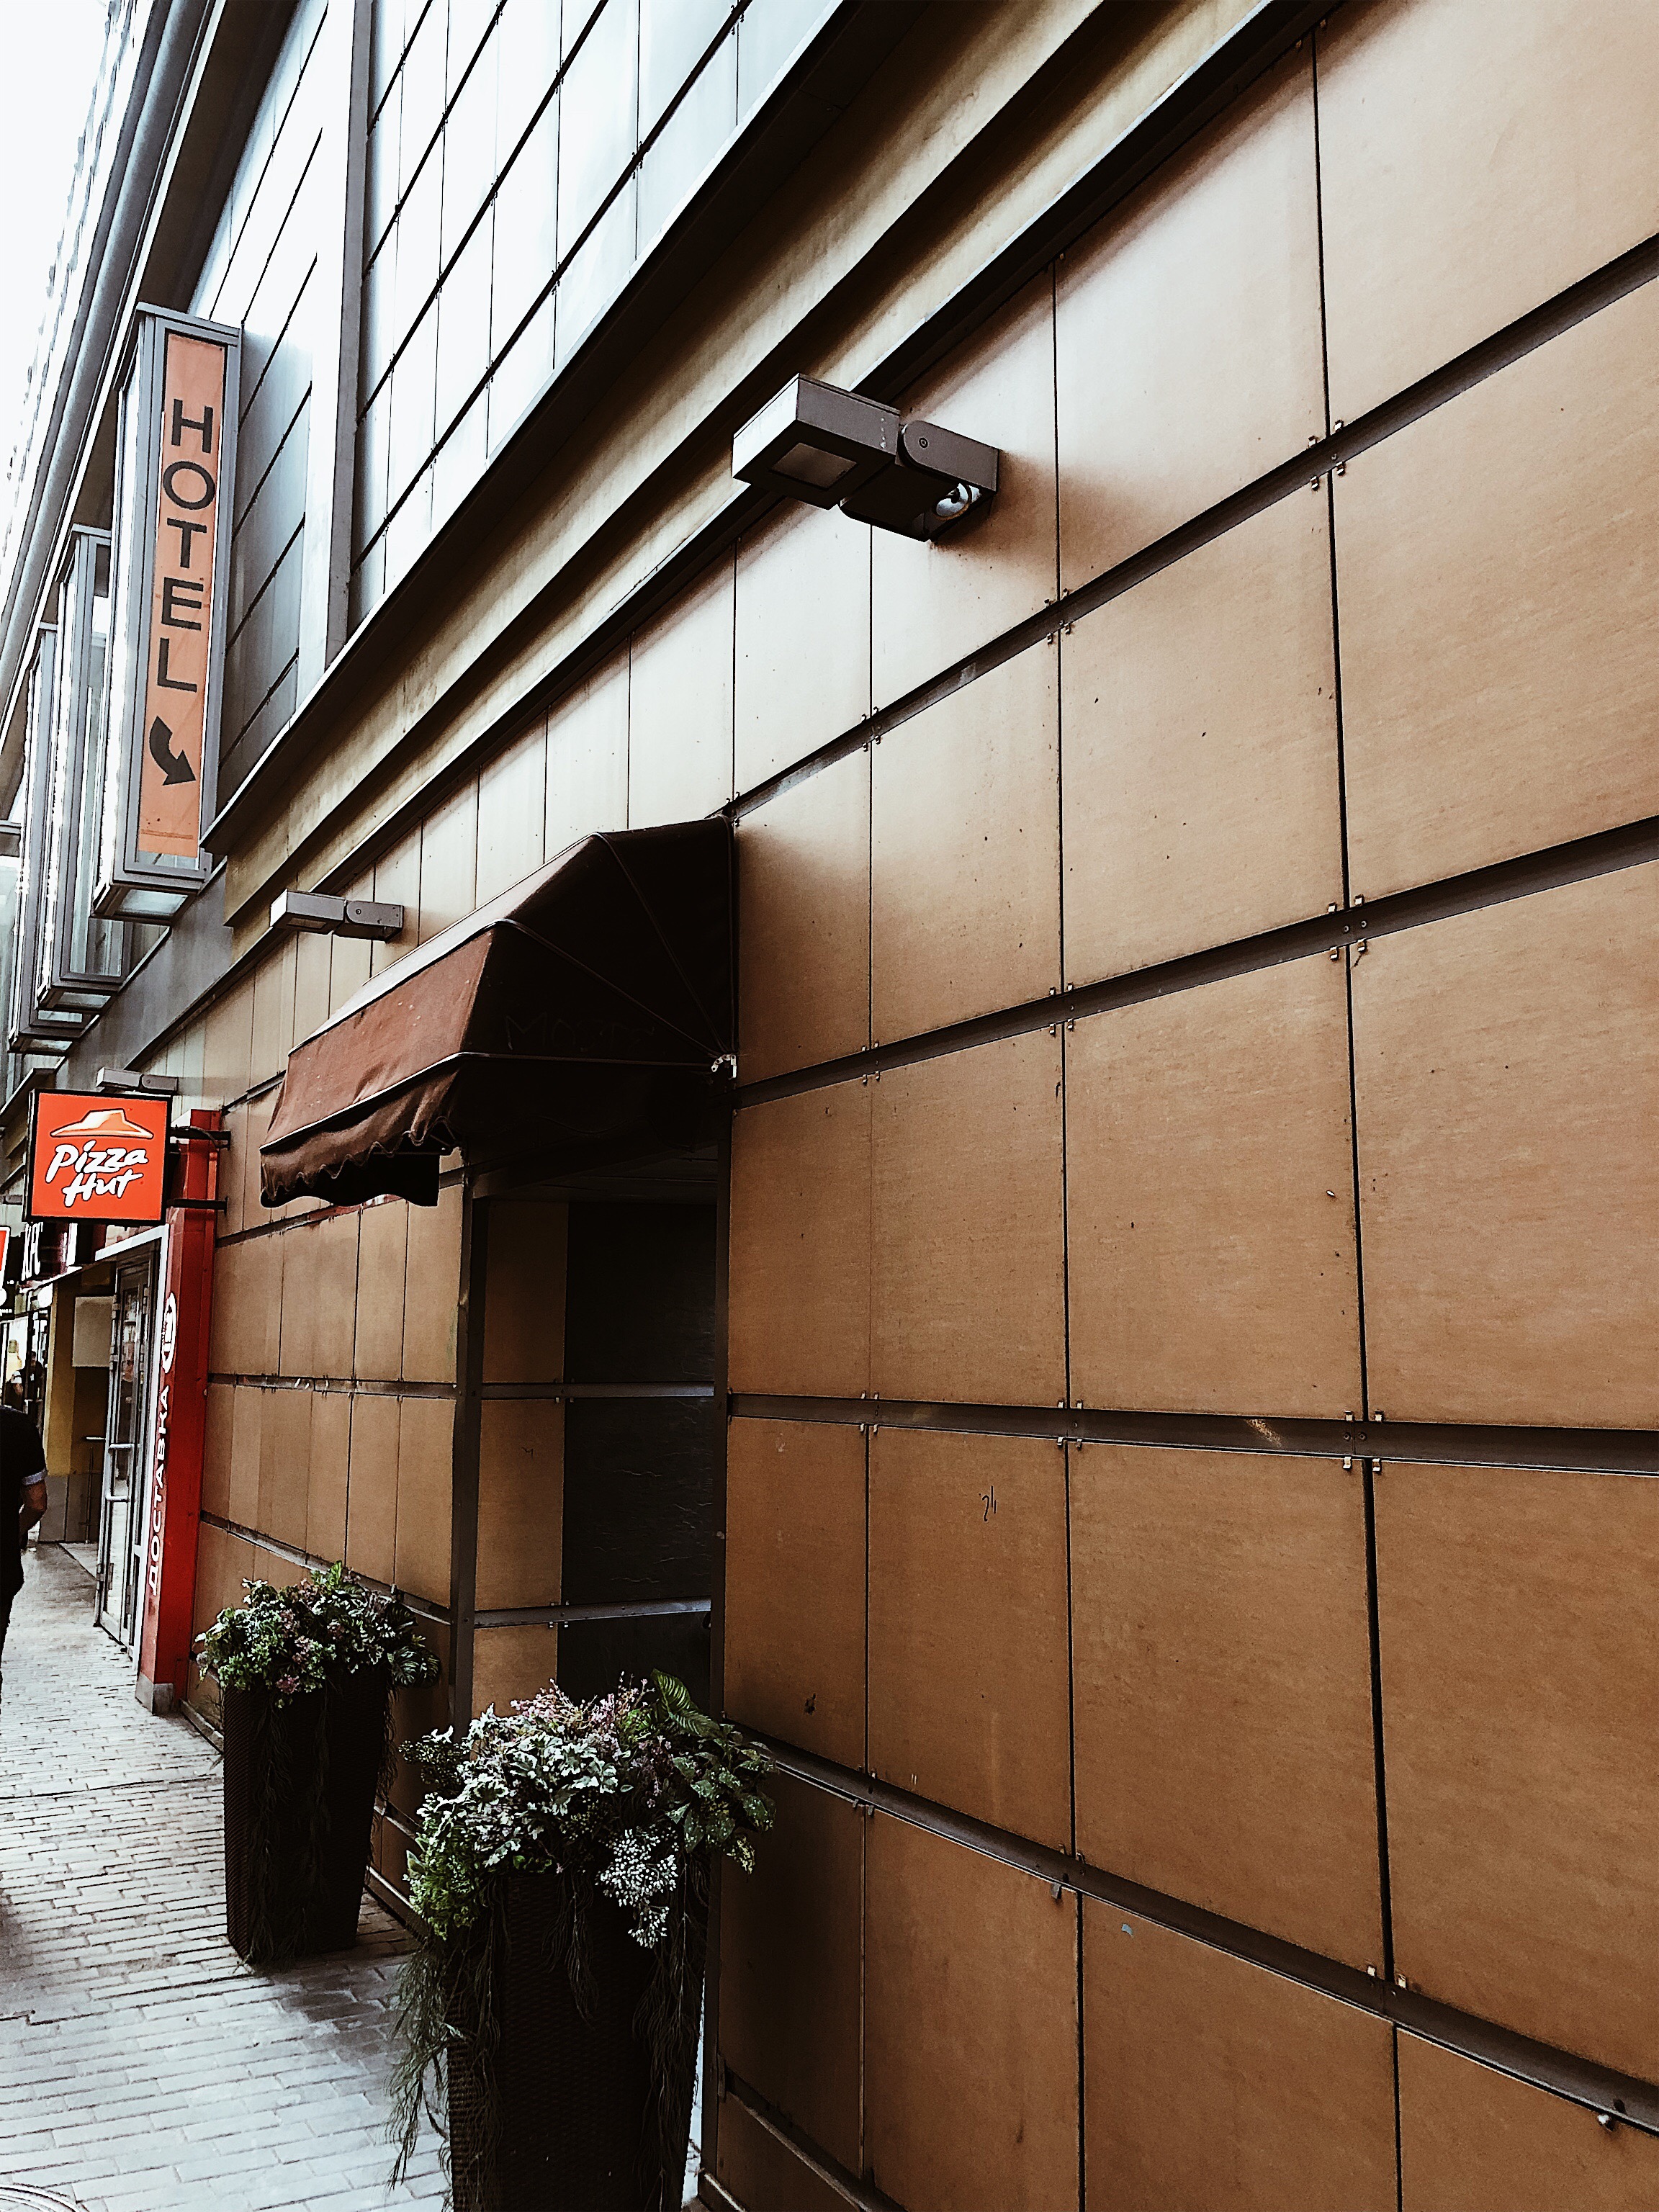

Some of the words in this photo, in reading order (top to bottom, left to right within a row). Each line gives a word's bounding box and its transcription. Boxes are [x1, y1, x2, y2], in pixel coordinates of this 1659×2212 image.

[157, 399, 216, 693] HOTEL
[45, 1140, 150, 1184] Pizza
[61, 1168, 144, 1208] Hut
[148, 1385, 170, 1596] ДОСТАВКА
